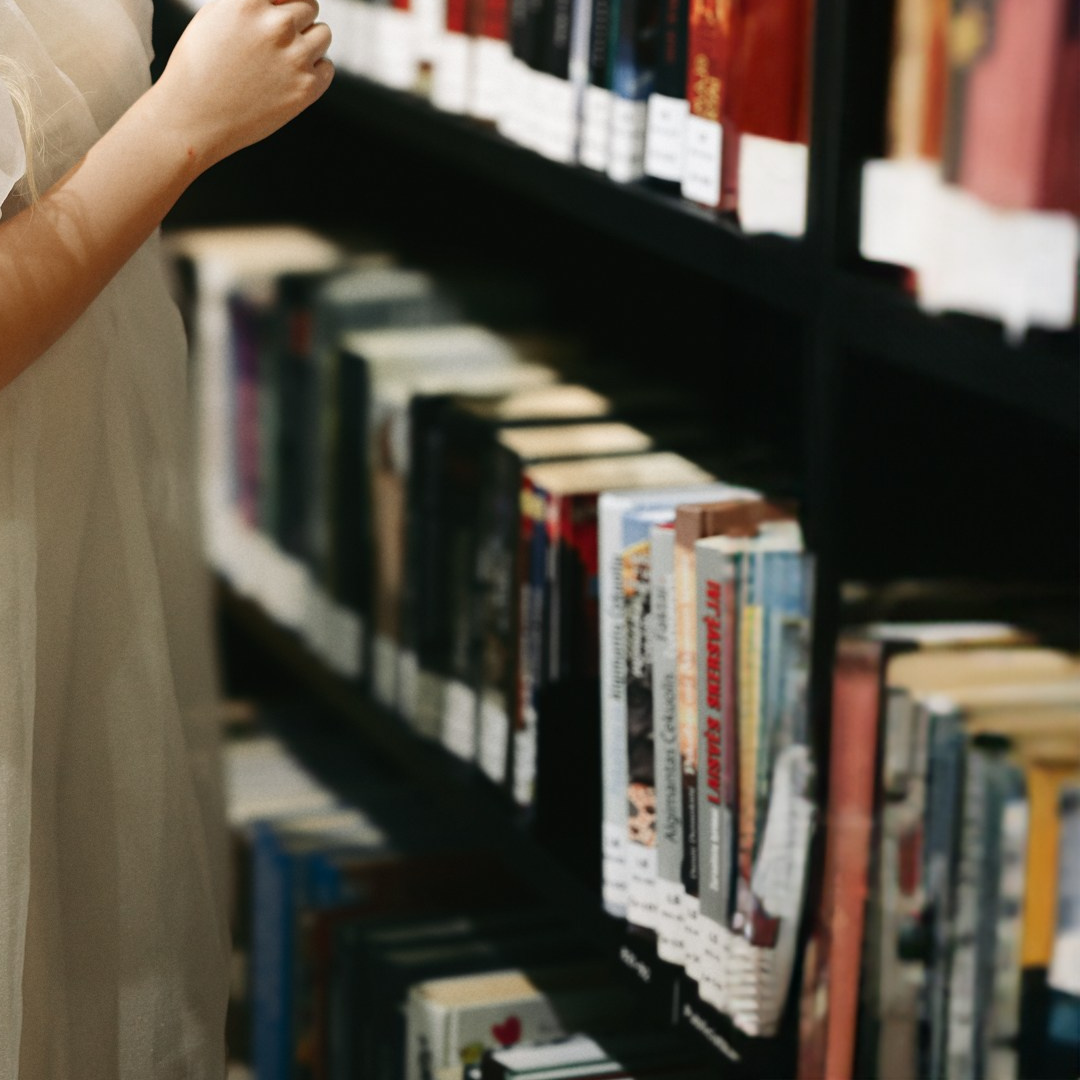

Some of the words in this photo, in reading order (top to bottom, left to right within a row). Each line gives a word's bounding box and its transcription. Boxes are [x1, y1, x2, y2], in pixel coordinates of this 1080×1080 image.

[704, 581, 721, 710] SKERSVĖJAI
[665, 748, 681, 843] Algimantas
[705, 717, 721, 804] LAISVĖS
